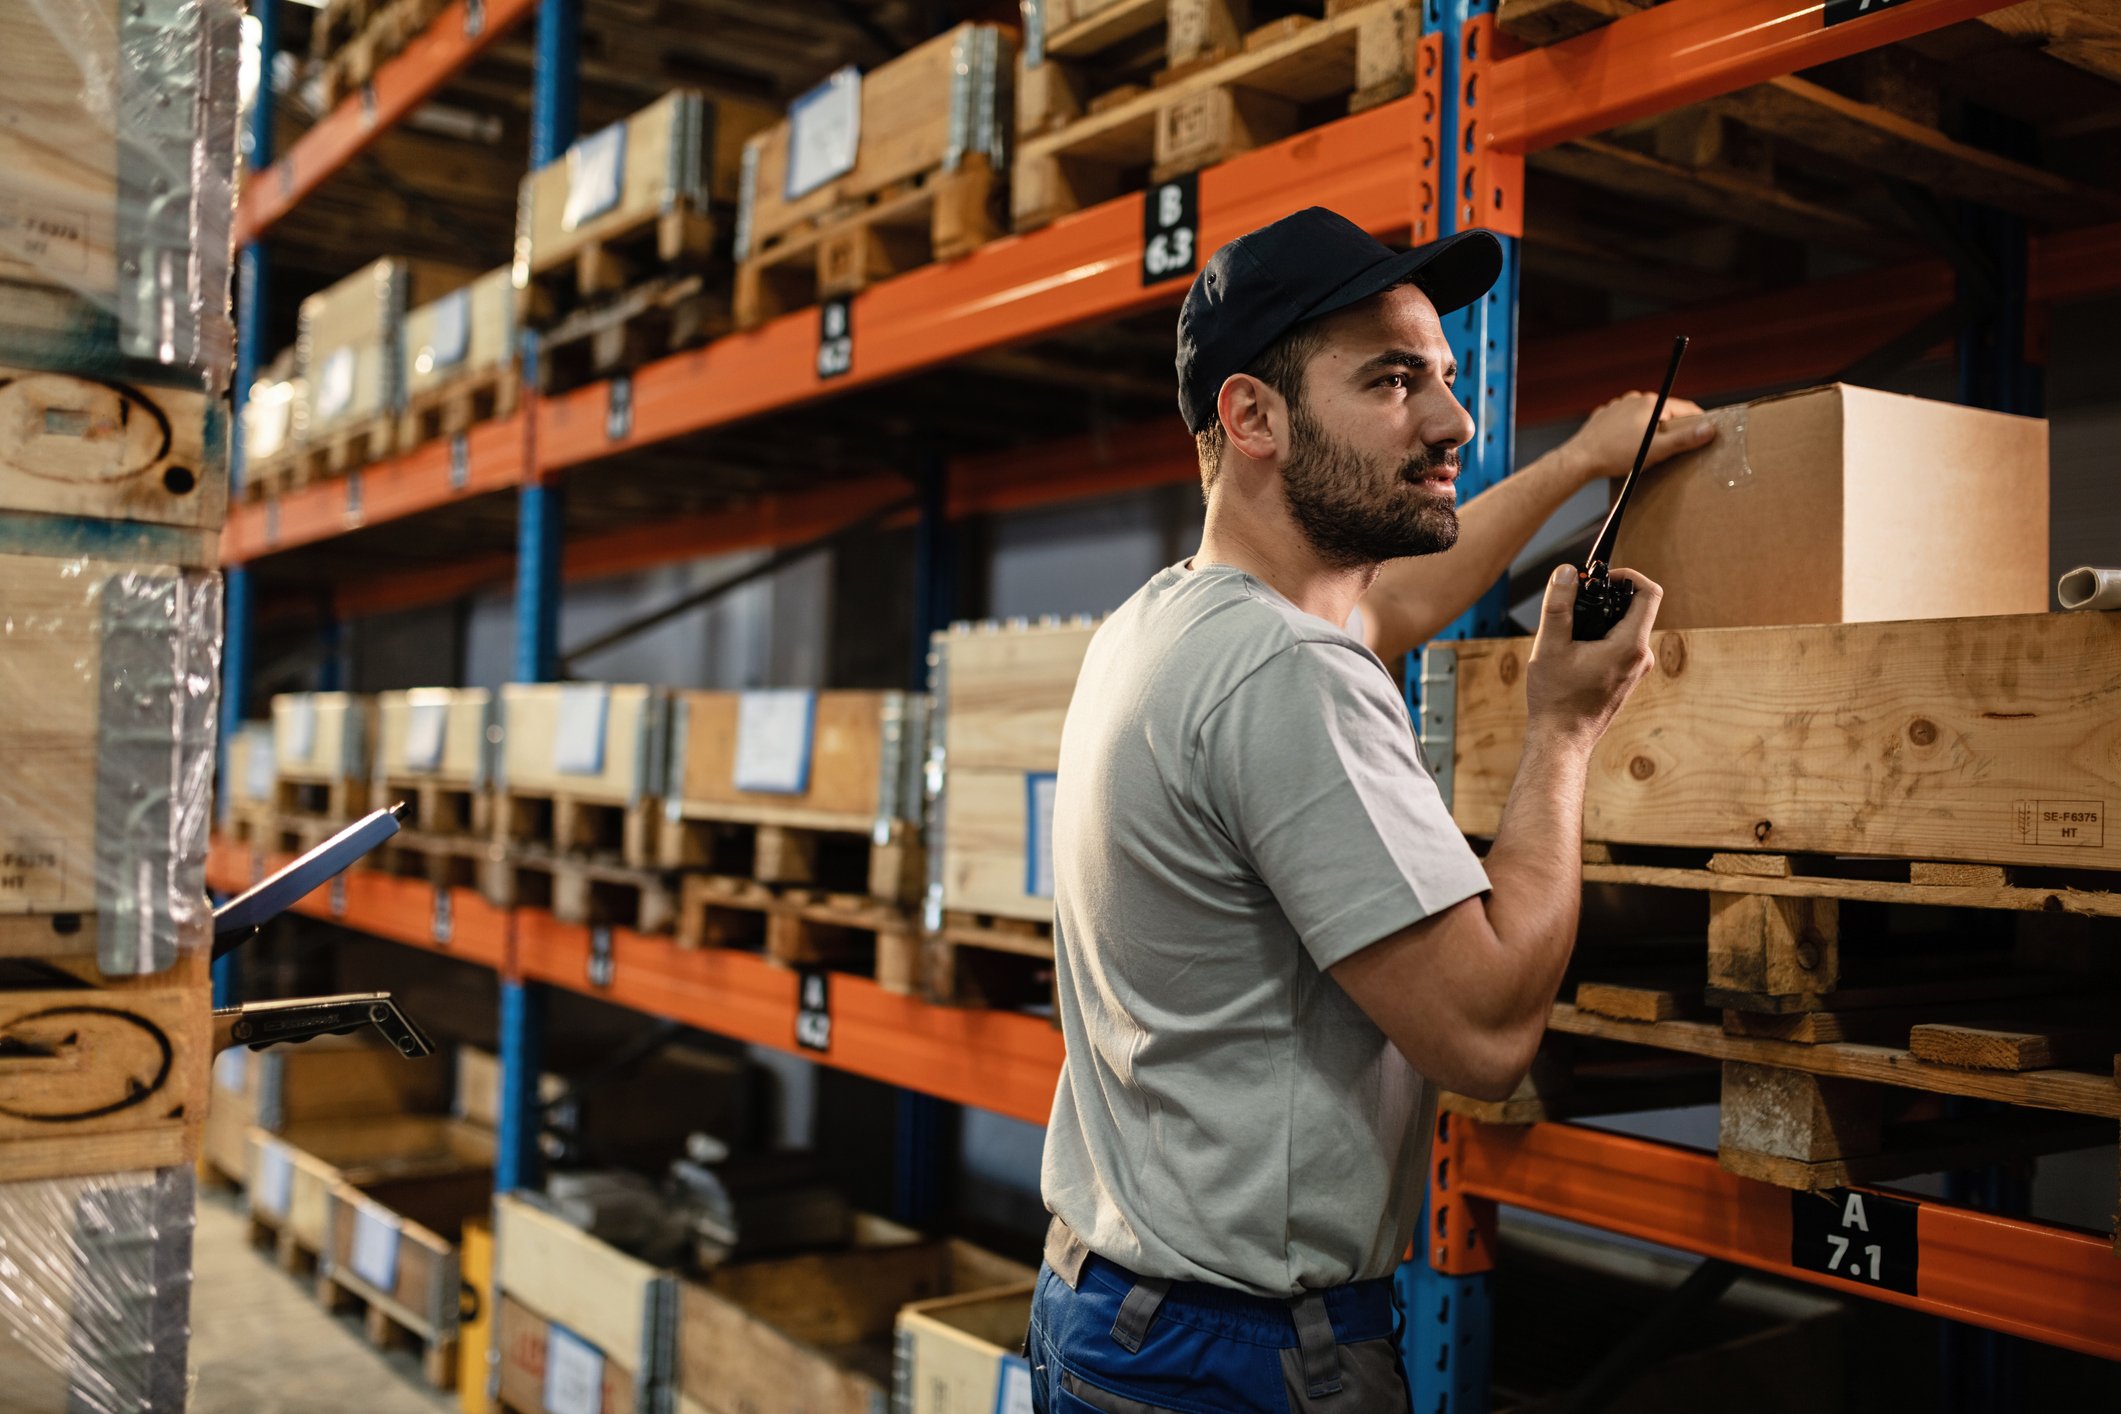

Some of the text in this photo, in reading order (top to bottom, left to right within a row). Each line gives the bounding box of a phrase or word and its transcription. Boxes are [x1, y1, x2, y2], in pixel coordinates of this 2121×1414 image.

[1159, 184, 1182, 227] B
[1146, 227, 1193, 274] 6.3
[2043, 812, 2097, 823] SE-F6375
[2062, 827, 2078, 838] HT
[1842, 1193, 1869, 1232] A
[1827, 1234, 1881, 1280] 7.1
